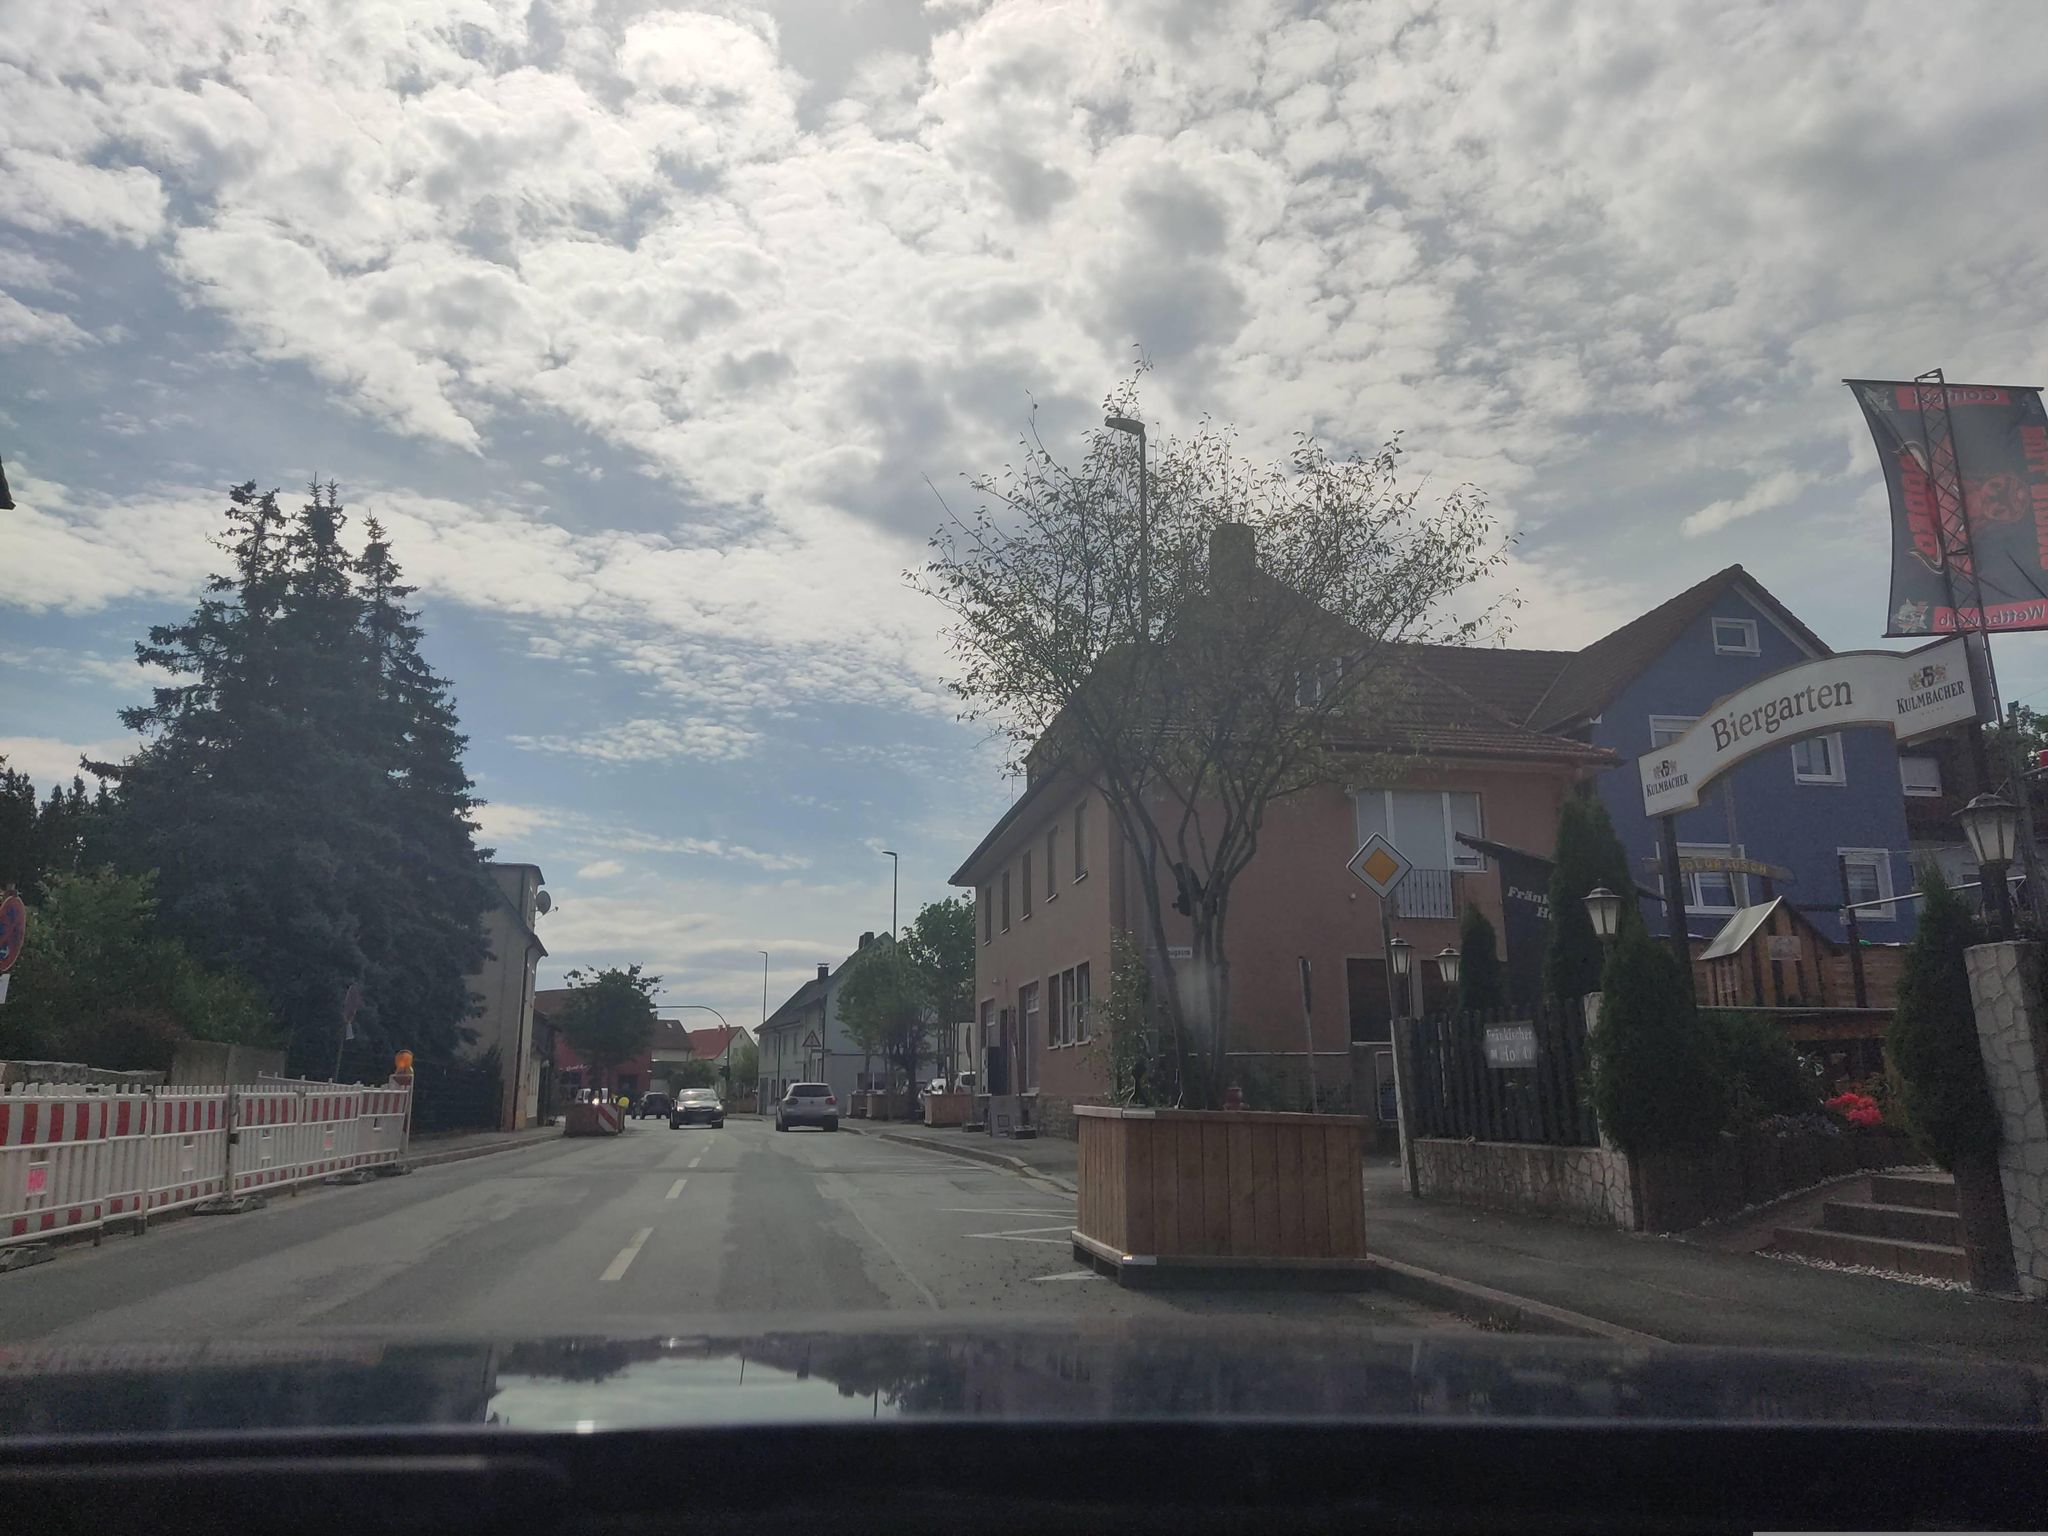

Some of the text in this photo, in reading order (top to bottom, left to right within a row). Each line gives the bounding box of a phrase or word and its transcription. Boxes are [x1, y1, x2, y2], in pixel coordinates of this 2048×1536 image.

[1896, 681, 1966, 715] KULMBACHER
[1711, 681, 1853, 752] Biergarten
[1646, 774, 1690, 797] KULMBACHER
[1508, 886, 1550, 904] Fränk
